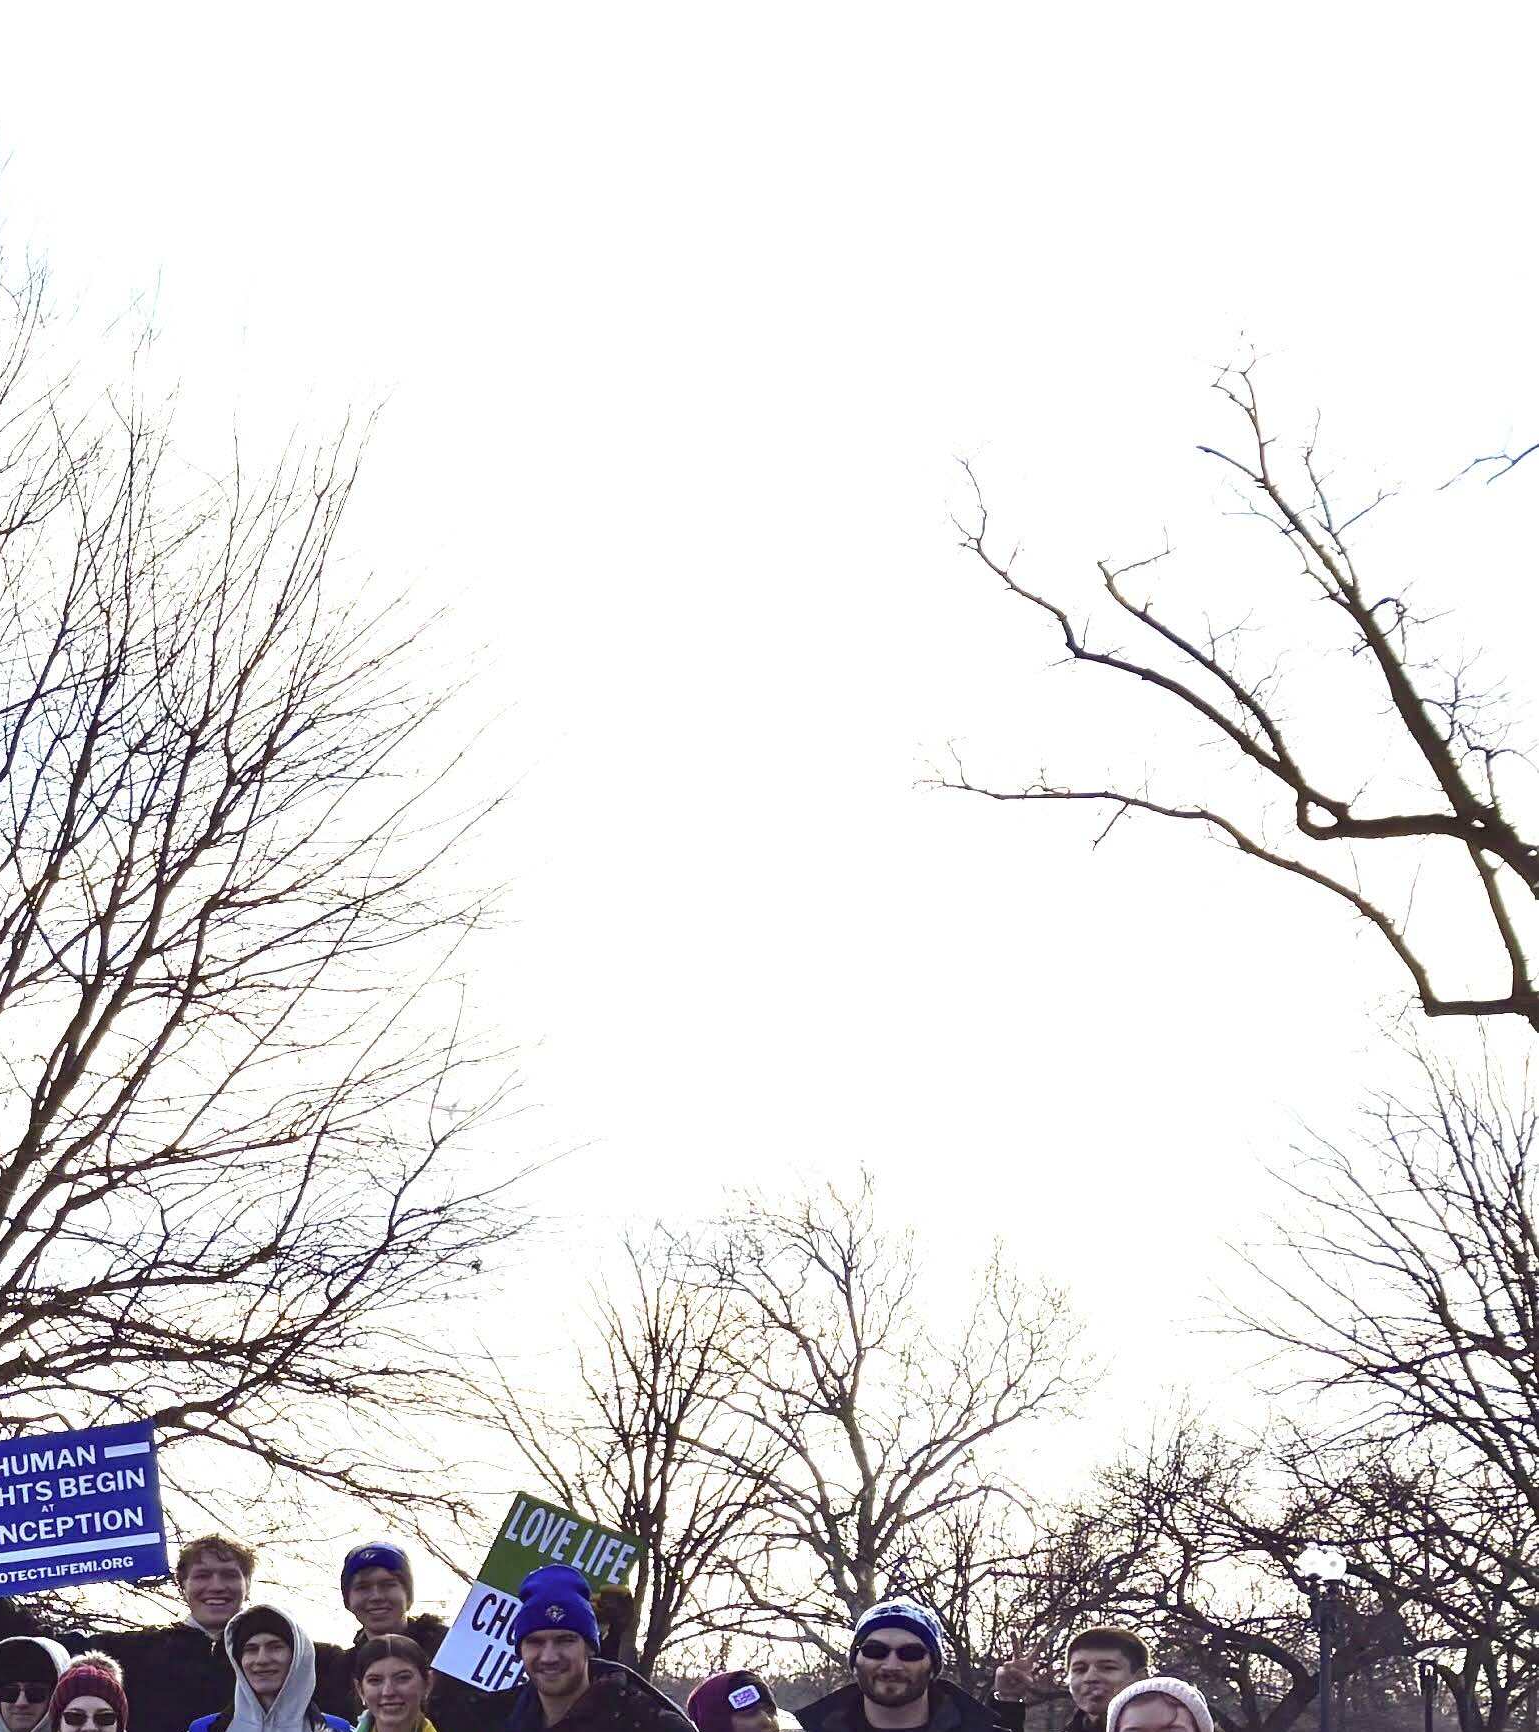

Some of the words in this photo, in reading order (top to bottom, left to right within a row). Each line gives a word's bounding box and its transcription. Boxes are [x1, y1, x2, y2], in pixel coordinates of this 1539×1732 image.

[59, 1467, 145, 1498] BEGIN
[41, 1503, 54, 1513] AT
[505, 1500, 578, 1561] LOVE
[571, 1529, 636, 1585] LIFE
